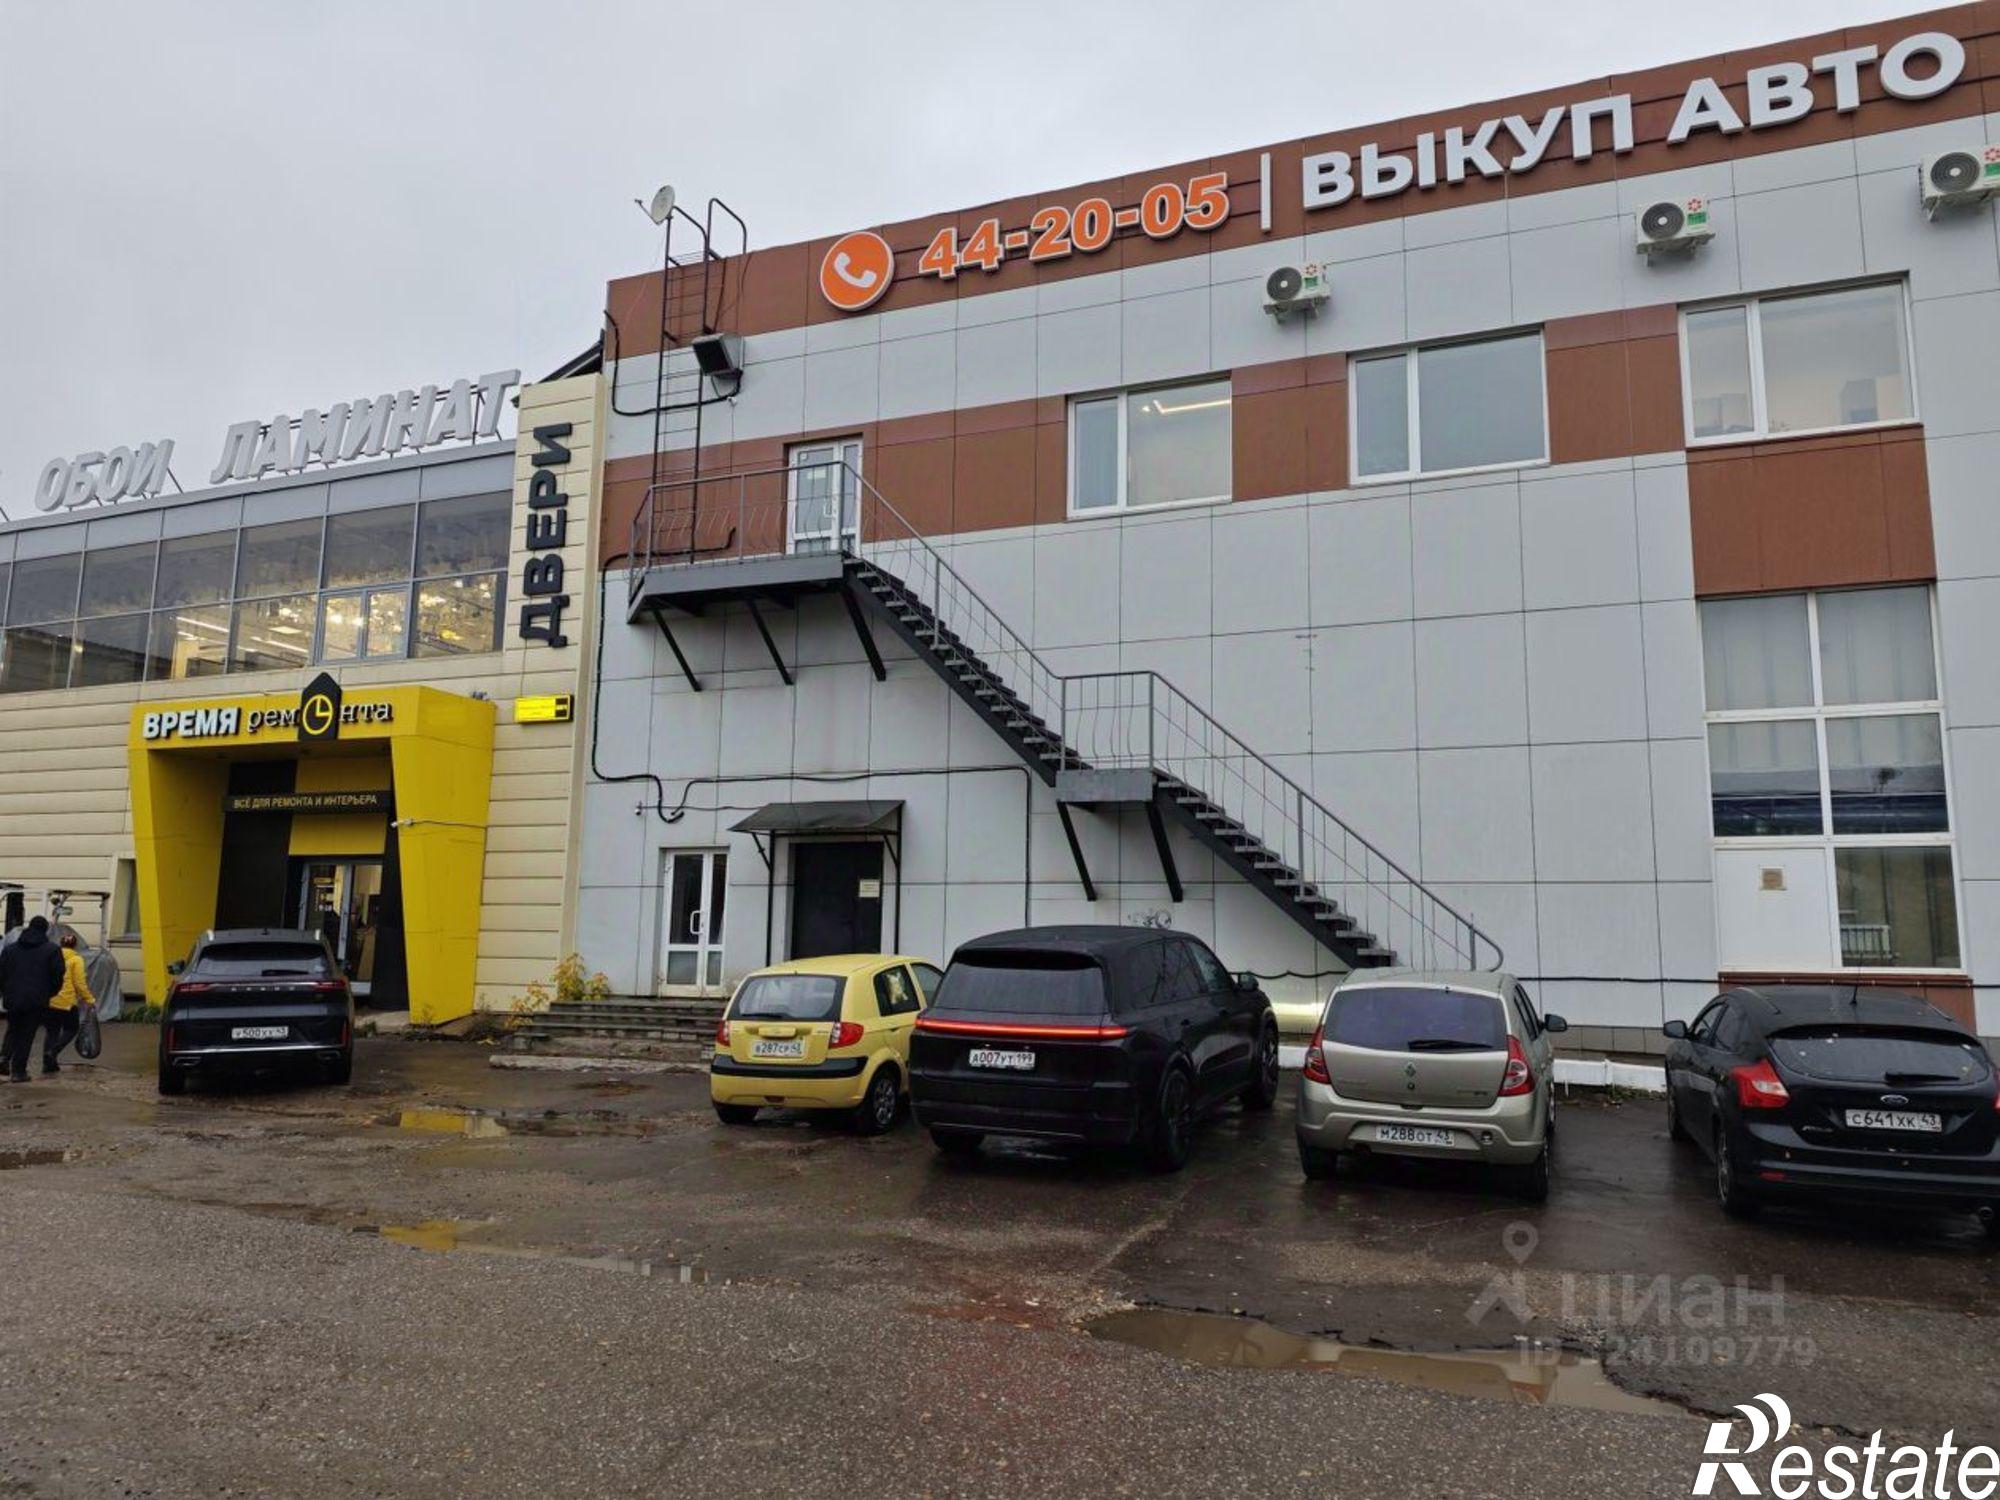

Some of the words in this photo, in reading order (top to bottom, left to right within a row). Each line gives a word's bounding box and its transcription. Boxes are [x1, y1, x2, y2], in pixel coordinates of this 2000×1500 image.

[1301, 93, 1635, 211] ВЫКУП
[1666, 31, 1966, 146] АВТО
[918, 171, 1231, 281] 44-20-05
[35, 439, 175, 512] ОБОИ
[210, 369, 521, 485] ЛАМИНАТ
[519, 422, 573, 647] ДВЕРИ
[142, 707, 241, 740] ВРЕМЯ
[251, 797, 271, 810] ДЛЯ
[272, 796, 313, 808] РЕМОНТА
[323, 794, 378, 806] ИНТЕРЬЕРА
